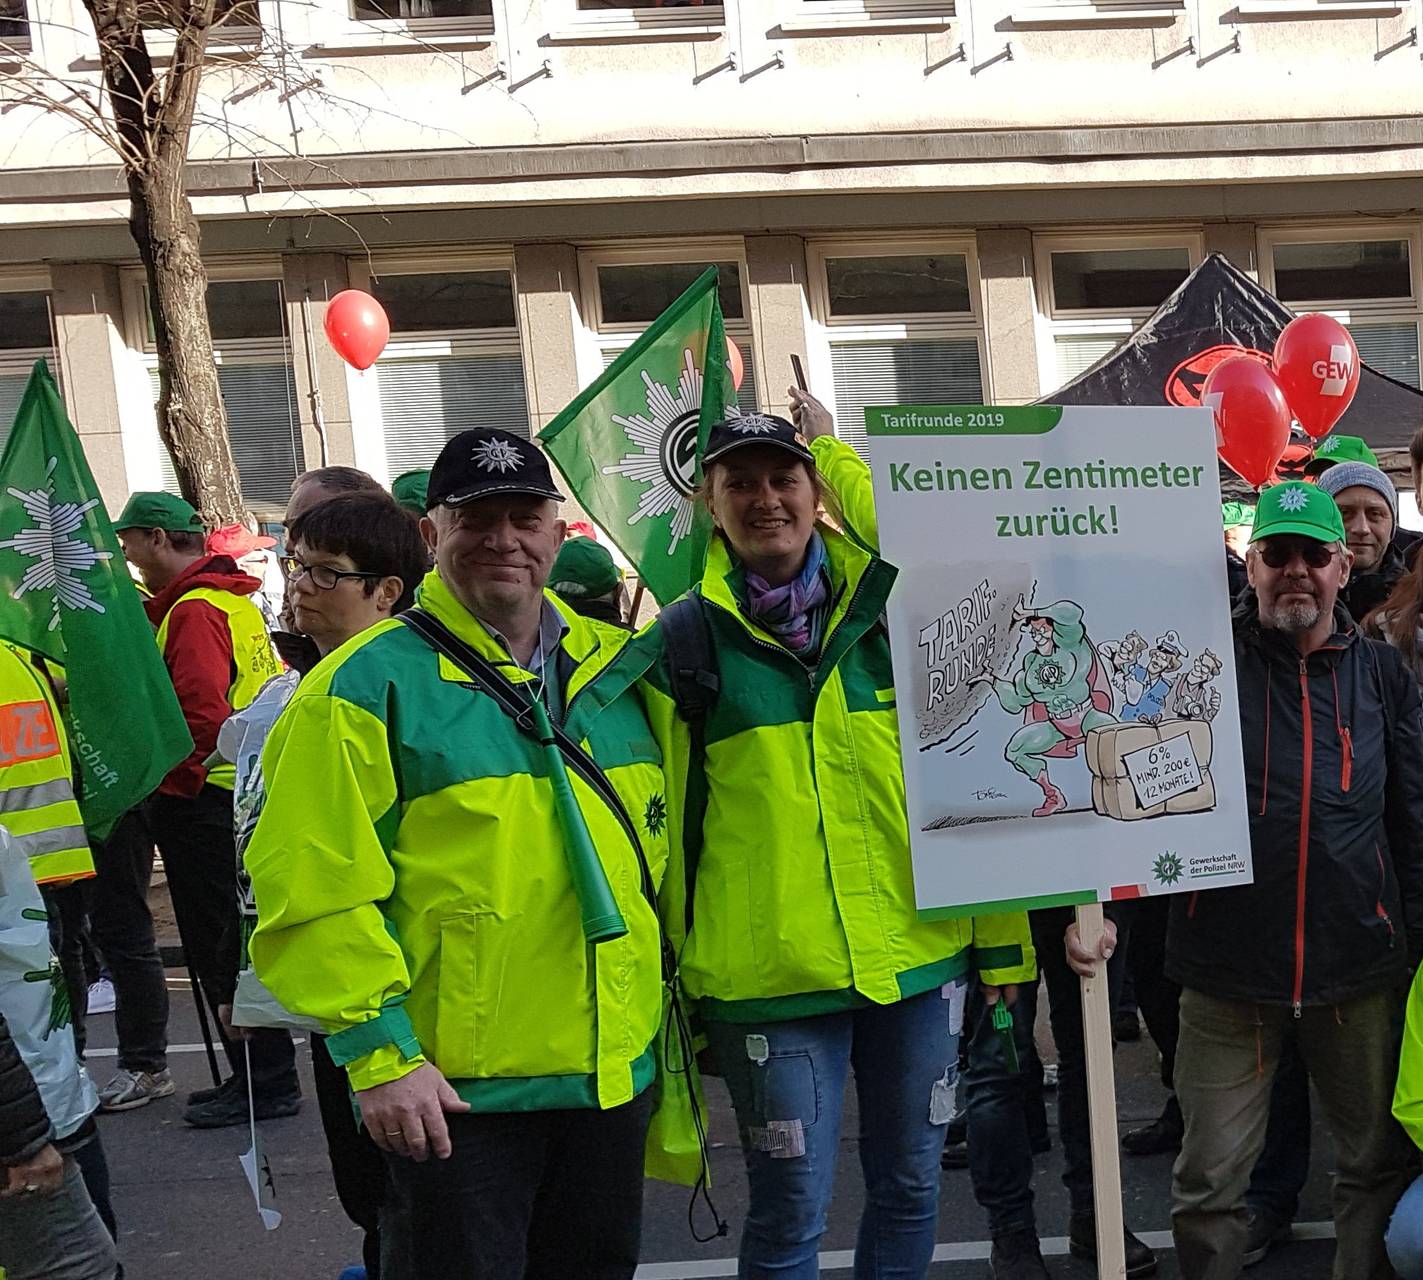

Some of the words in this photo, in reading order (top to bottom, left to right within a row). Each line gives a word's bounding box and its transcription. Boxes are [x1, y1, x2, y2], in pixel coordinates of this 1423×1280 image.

[1312, 360, 1352, 380] GEW
[880, 412, 963, 428] Tarifrunde
[966, 413, 1005, 428] 2019
[888, 461, 1013, 492] Keinen
[1021, 458, 1204, 490] Zentimeter
[995, 504, 1119, 537] zurück!
[1148, 746, 1171, 765] 6%
[1136, 766, 1161, 785] MIND.
[1143, 785, 1159, 799] 12
[1159, 772, 1195, 794] MONATE!
[1189, 853, 1237, 866] Gewerkschaft
[1203, 863, 1226, 873] Polizei
[1227, 861, 1246, 870] NRW
